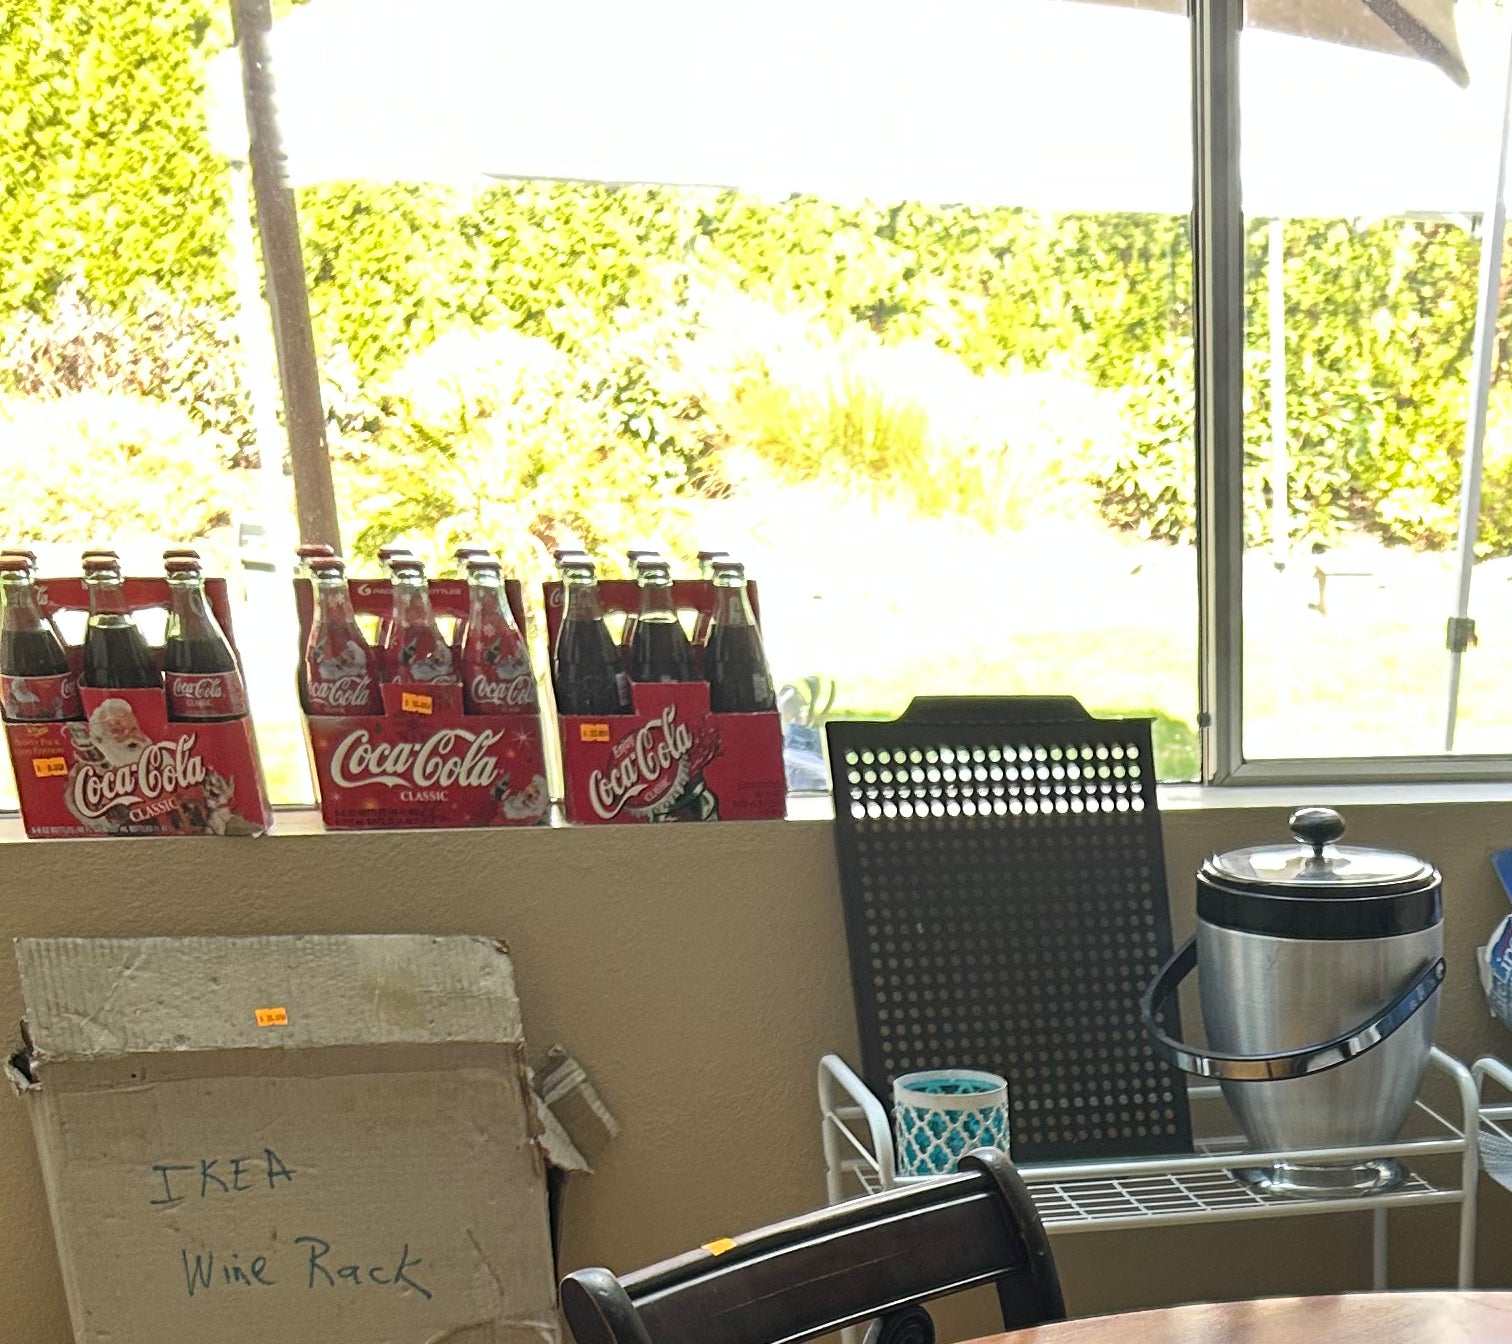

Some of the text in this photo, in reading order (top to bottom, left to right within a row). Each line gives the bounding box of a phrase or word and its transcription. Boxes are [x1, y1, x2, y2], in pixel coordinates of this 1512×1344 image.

[172, 677, 224, 700] Coca-Cola
[72, 732, 207, 819] Coca-Cola
[330, 728, 505, 789] Coca-Cola
[589, 703, 693, 820] Coca-Cola
[129, 795, 180, 823] CLASSIC
[400, 790, 449, 802] CLASSIC
[149, 1147, 297, 1206] IKEA
[181, 1236, 433, 1300] Wine Rack
